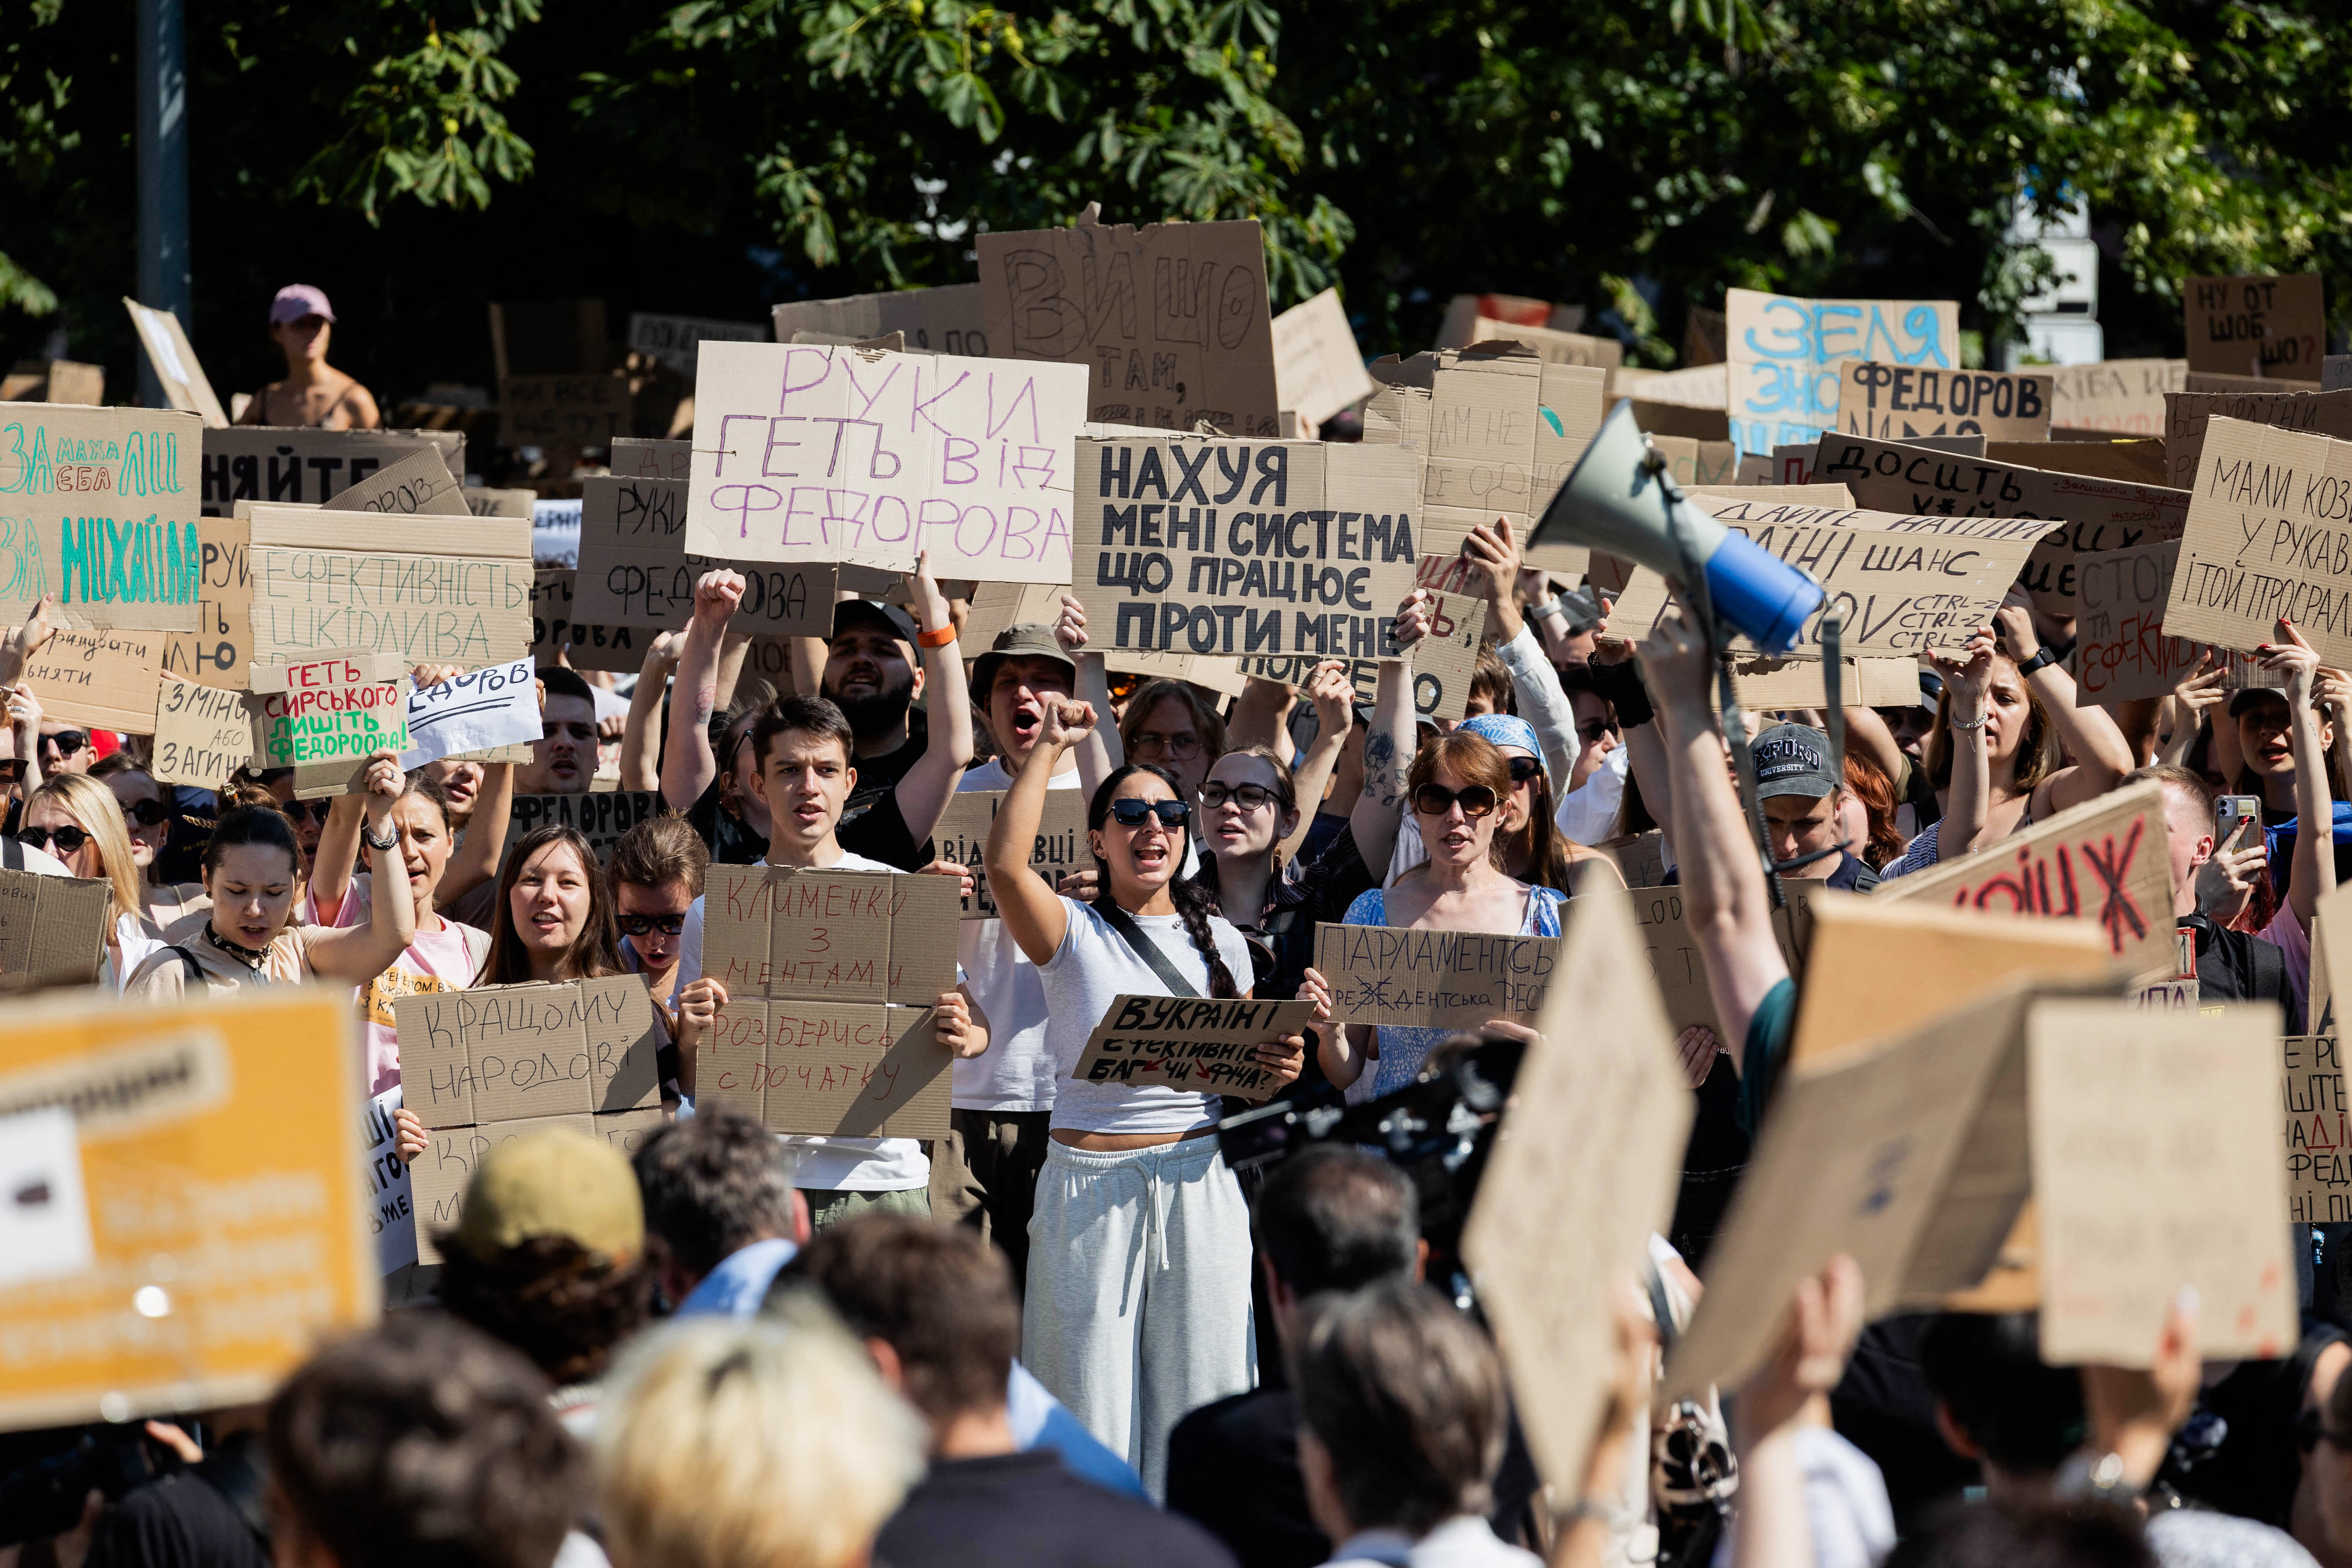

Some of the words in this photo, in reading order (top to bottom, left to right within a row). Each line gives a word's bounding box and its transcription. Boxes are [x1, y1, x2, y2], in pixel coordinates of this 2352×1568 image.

[2198, 283, 2227, 310] НУ
[2244, 281, 2277, 311] ОТ
[1745, 299, 1949, 368] ЗЕЛЯ
[2209, 311, 2266, 342] ШОБ
[780, 348, 1040, 443] РУКИ
[1853, 361, 2043, 418] ФЕДОРОВ
[716, 414, 902, 479] ГЕТЬ
[943, 436, 1056, 490] ВІД
[1100, 445, 1287, 506] НАХУЯ
[1827, 445, 2023, 503] ДОСИТЬ
[2210, 456, 2293, 512] МАЛИ
[710, 484, 1073, 563] ФЕДОРОВА
[1101, 504, 1216, 553] МЕНІ
[1227, 510, 1415, 564] СИСТЕМА
[2237, 512, 2267, 556] У
[2270, 518, 2352, 575] РУКАВ
[267, 551, 524, 609] ЕФЕКТИВНІСТЬ
[1096, 552, 1173, 597] ЩО
[1187, 556, 1372, 611] ПРАЦЮЄ
[1860, 544, 1981, 576] ШАНС
[271, 605, 490, 660] ШКІДЛИВА
[1115, 602, 1282, 655] ПРОТИ
[1294, 611, 1405, 658] МЕНЕ
[1899, 612, 1987, 629] CTRL-Z
[2088, 610, 2112, 639] ТА
[2246, 573, 2352, 639] ПРОСРАЛ
[287, 659, 360, 688] ГЕТЬ
[405, 664, 530, 715] ЕДОРОВ
[265, 686, 397, 719] СИРСЬКОГО
[269, 710, 379, 738] ЛИШІТЬ
[1760, 764, 1804, 776] UNIVERSITY
[728, 876, 907, 922] КЛИМЕНКО
[806, 928, 830, 952] З
[725, 958, 902, 989] МЕНТАМИ
[424, 990, 626, 1048] КРАЩОМУ
[430, 1036, 629, 1104] НАРОДОВІ
[1087, 1058, 1149, 1080] БАГ
[1165, 1059, 1193, 1081] ЧИ
[1209, 1060, 1273, 1090] ФІЧА?
[2286, 1154, 2352, 1189] ФЕД
